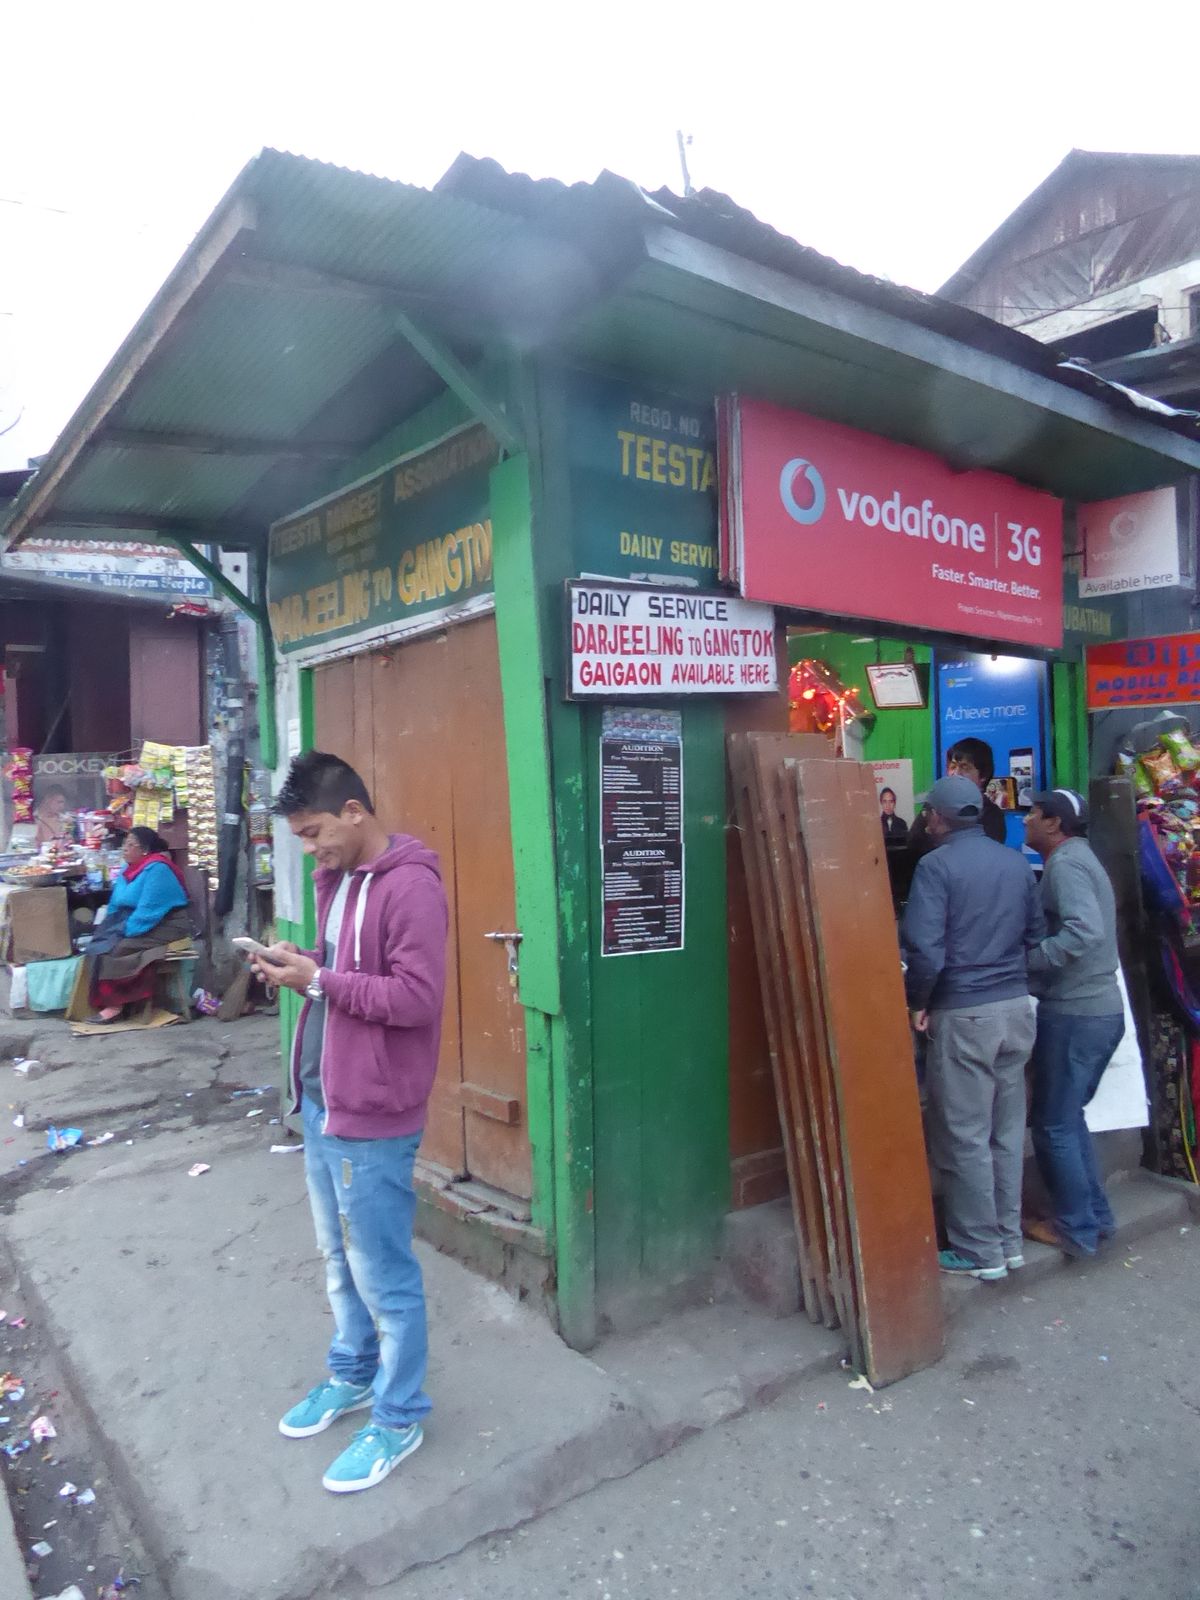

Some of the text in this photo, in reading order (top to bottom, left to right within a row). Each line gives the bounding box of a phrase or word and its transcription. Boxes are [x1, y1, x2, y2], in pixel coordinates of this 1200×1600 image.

[837, 487, 986, 553] vodafone
[1007, 522, 1042, 566] 3G
[620, 532, 663, 561] DAILY
[932, 563, 1041, 600] Faster. Smarter. Better.
[1084, 571, 1174, 594] Available here
[578, 591, 728, 621] DAILY SERVICE
[573, 622, 774, 657] DARJEELING TO GANGTOK
[580, 660, 770, 686] GAIGAON AVAILABLE HERE
[945, 704, 991, 720] Achieve
[621, 744, 664, 752] AUDITION
[35, 757, 111, 776] JOCKEY
[622, 849, 666, 857] AUDITION
